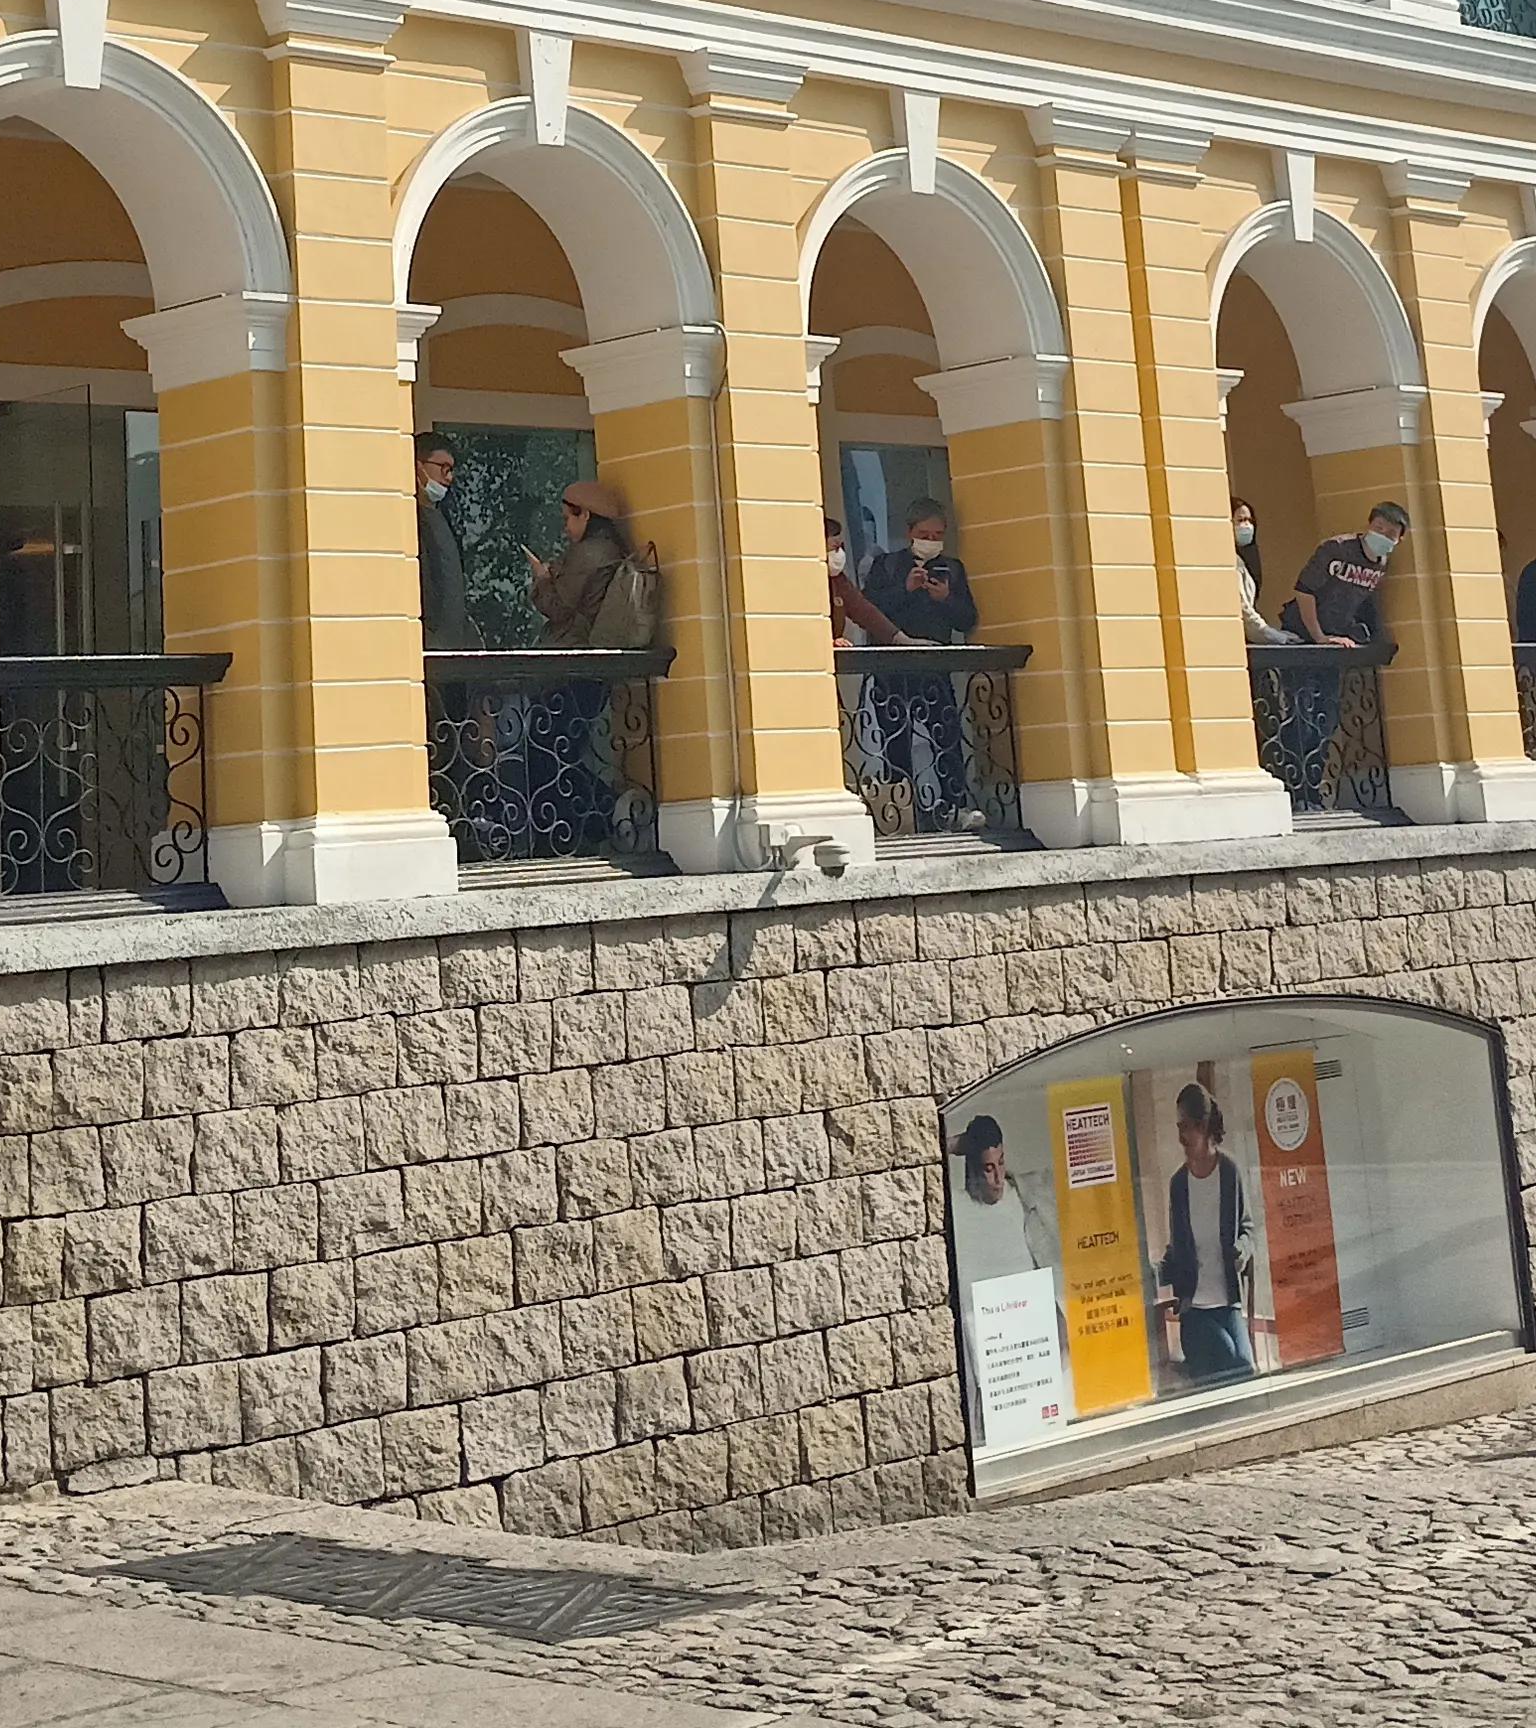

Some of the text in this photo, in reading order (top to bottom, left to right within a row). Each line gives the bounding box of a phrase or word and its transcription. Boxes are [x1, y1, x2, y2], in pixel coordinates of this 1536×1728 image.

[1065, 1113, 1111, 1132] HEATTECH
[1279, 1167, 1307, 1188] NEW
[1076, 1231, 1120, 1249] HEATTECH
